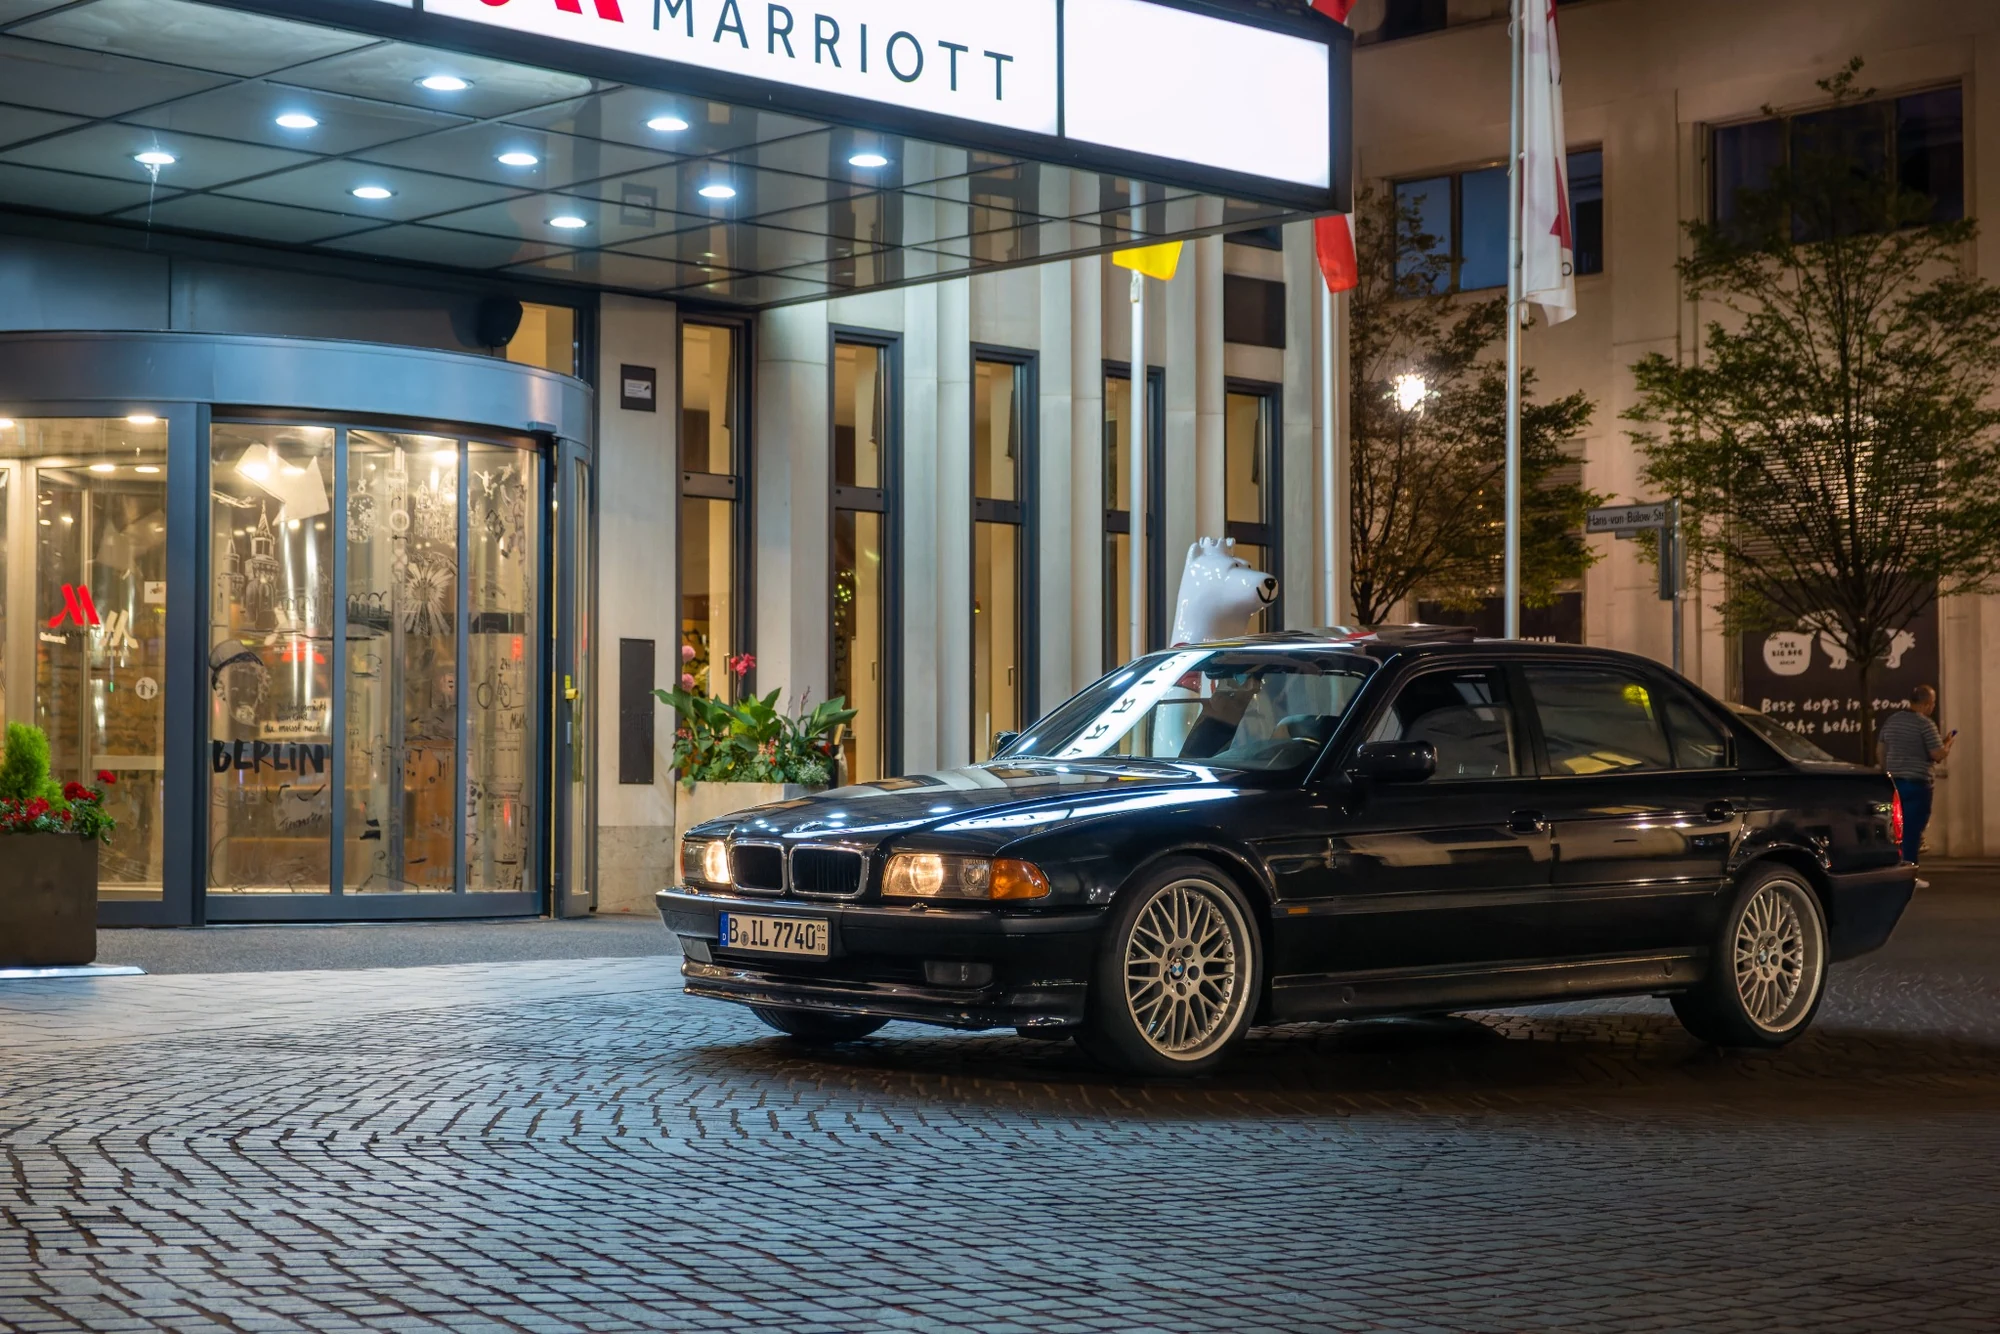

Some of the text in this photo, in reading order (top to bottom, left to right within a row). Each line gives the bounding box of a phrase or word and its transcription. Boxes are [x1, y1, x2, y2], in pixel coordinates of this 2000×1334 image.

[653, 0, 1014, 102] MARRIOTT
[1761, 698, 1796, 713] Best
[1803, 698, 1839, 714] dogs
[729, 917, 816, 950] B IL 7740
